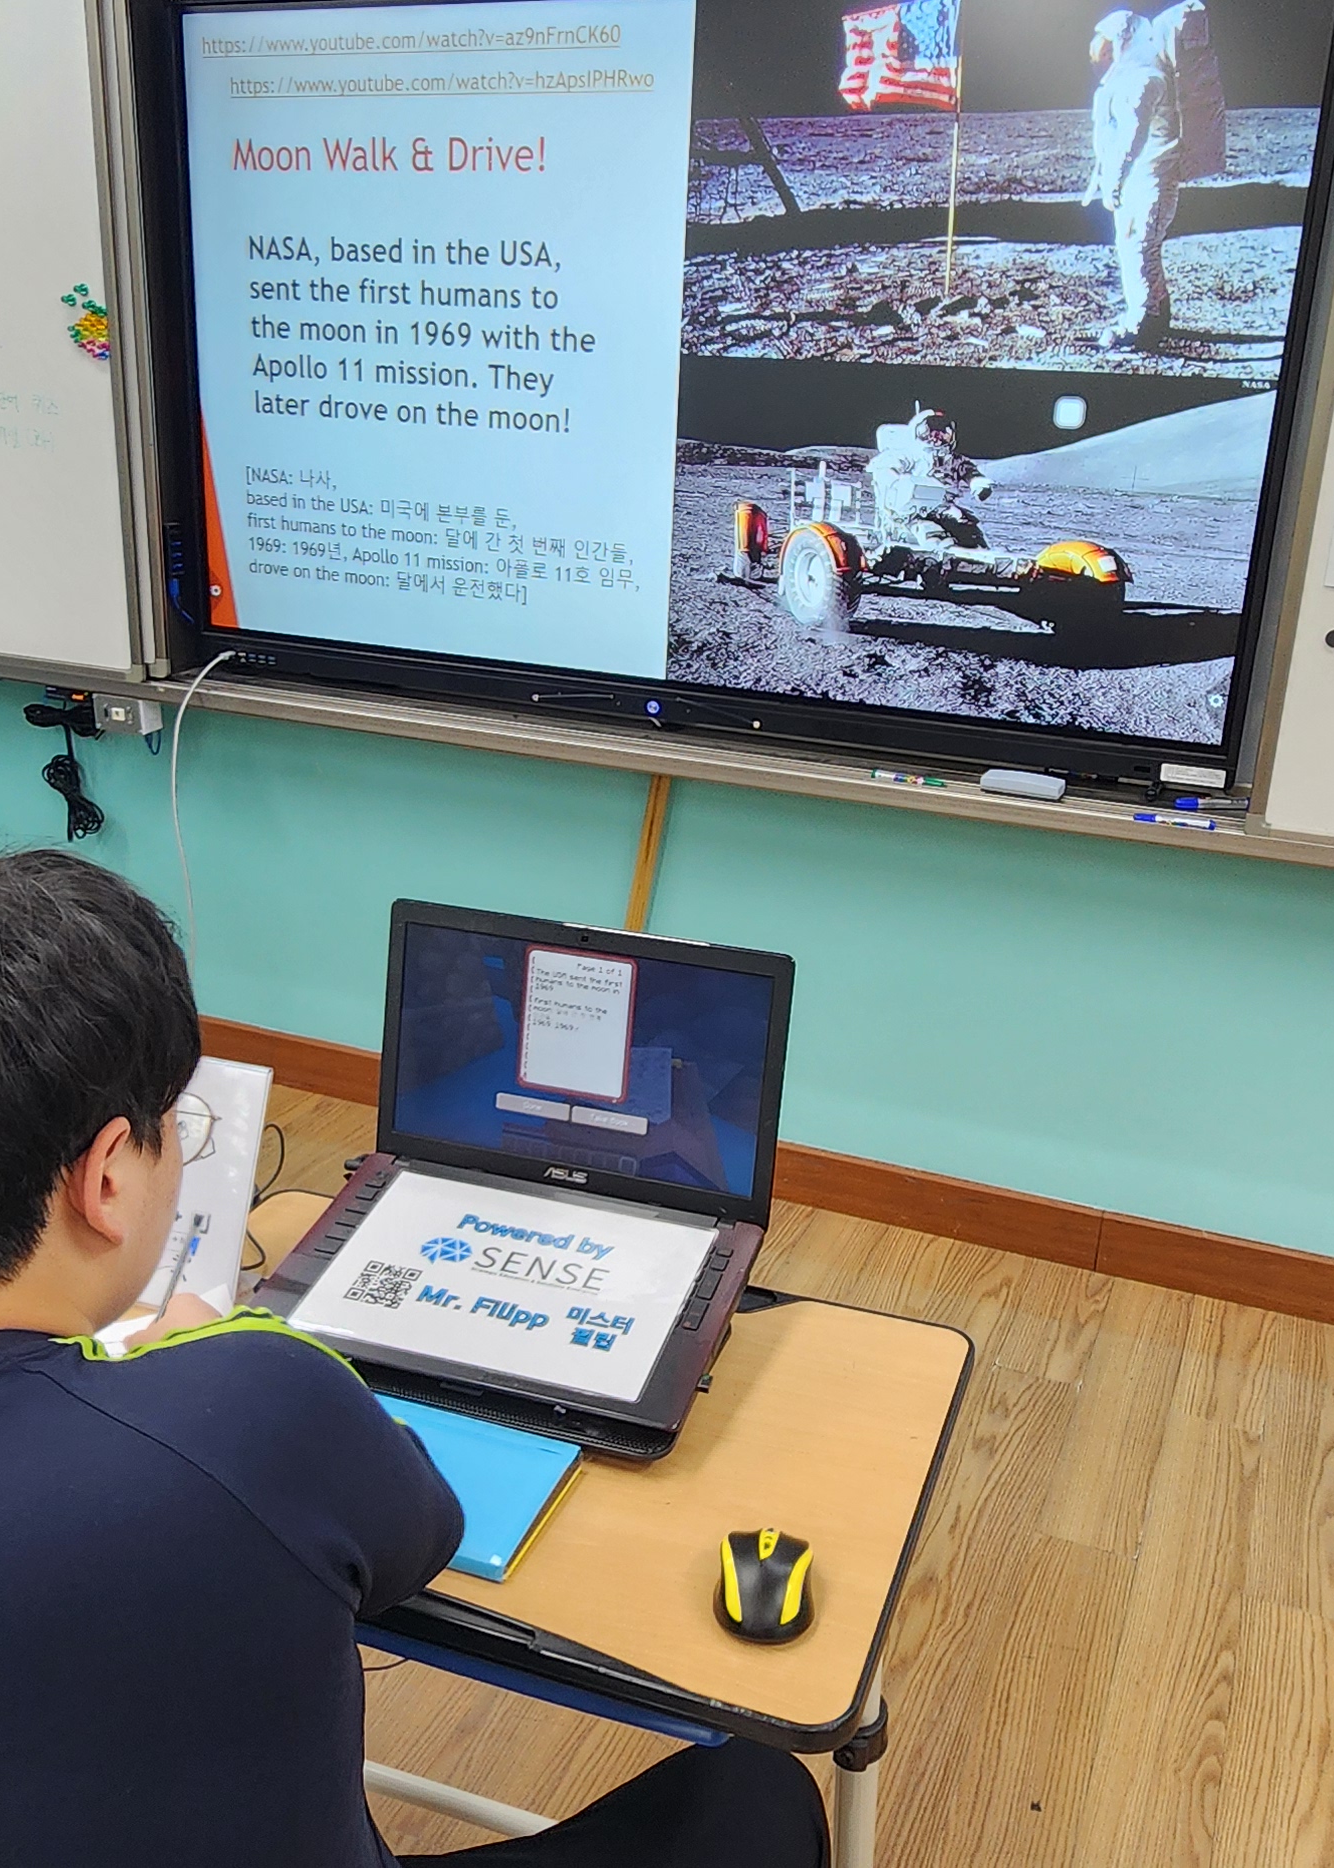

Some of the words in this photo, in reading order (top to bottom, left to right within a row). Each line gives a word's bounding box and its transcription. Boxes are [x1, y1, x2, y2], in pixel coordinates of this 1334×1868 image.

[232, 138, 311, 171] Moon
[322, 137, 398, 171] Walk
[411, 138, 434, 171] &
[448, 136, 546, 172] Drive!
[248, 236, 321, 266] NASA,
[330, 237, 403, 265] based
[412, 238, 436, 266] in
[445, 239, 489, 266] the
[500, 241, 563, 272] USA,
[249, 279, 300, 302] sent
[309, 278, 351, 303] the
[359, 278, 411, 305] first
[420, 280, 521, 309] humans
[532, 286, 558, 310] to
[251, 316, 291, 339] the
[299, 322, 367, 343] moon
[376, 320, 399, 345] in
[411, 322, 472, 348] 1969
[482, 326, 541, 352] with
[550, 327, 596, 353] the
[252, 353, 327, 384] Apollo
[338, 357, 364, 382] 11
[375, 361, 478, 388] mission.
[488, 363, 554, 396] They
[255, 391, 310, 416] later
[319, 391, 389, 421] drove
[397, 405, 427, 424] on
[436, 400, 479, 427] the
[489, 407, 571, 433] moon!
[246, 466, 293, 485] [NASA:
[300, 469, 337, 491] 나사,
[247, 490, 287, 507] based
[293, 494, 306, 509] in
[311, 495, 335, 511] the
[340, 498, 373, 515] USA:
[380, 500, 429, 522] 미국에
[436, 504, 487, 526] 본부를
[494, 508, 516, 531] 둔,
[247, 513, 276, 530] first
[281, 515, 336, 535] humans
[341, 523, 356, 537] to
[362, 524, 386, 540] the
[392, 529, 438, 544] moon:
[445, 528, 478, 550] 달에
[485, 532, 501, 552] 간
[508, 535, 524, 554] 첫
[532, 536, 566, 558] 번째
[574, 539, 633, 565] 인간들,
[248, 537, 287, 553] 1969:
[293, 541, 347, 562] 1969년,
[352, 548, 399, 565] Apollo
[404, 552, 420, 567] 11
[427, 554, 489, 574] mission:
[496, 557, 548, 580] 아폴로
[555, 566, 591, 584] 11호
[599, 567, 640, 592] 임무,
[249, 559, 289, 576] drove
[293, 566, 311, 579] on
[316, 566, 340, 582] the
[345, 571, 390, 587] moon:
[397, 571, 445, 594] 달에서
[452, 577, 528, 605] 운전했다]
[543, 1166, 589, 1184] ASUS
[456, 1213, 575, 1250] Powered
[576, 1237, 615, 1260] by
[474, 1246, 610, 1291] SENSE
[416, 1284, 463, 1310] Mr.
[566, 1306, 636, 1335] 미스터
